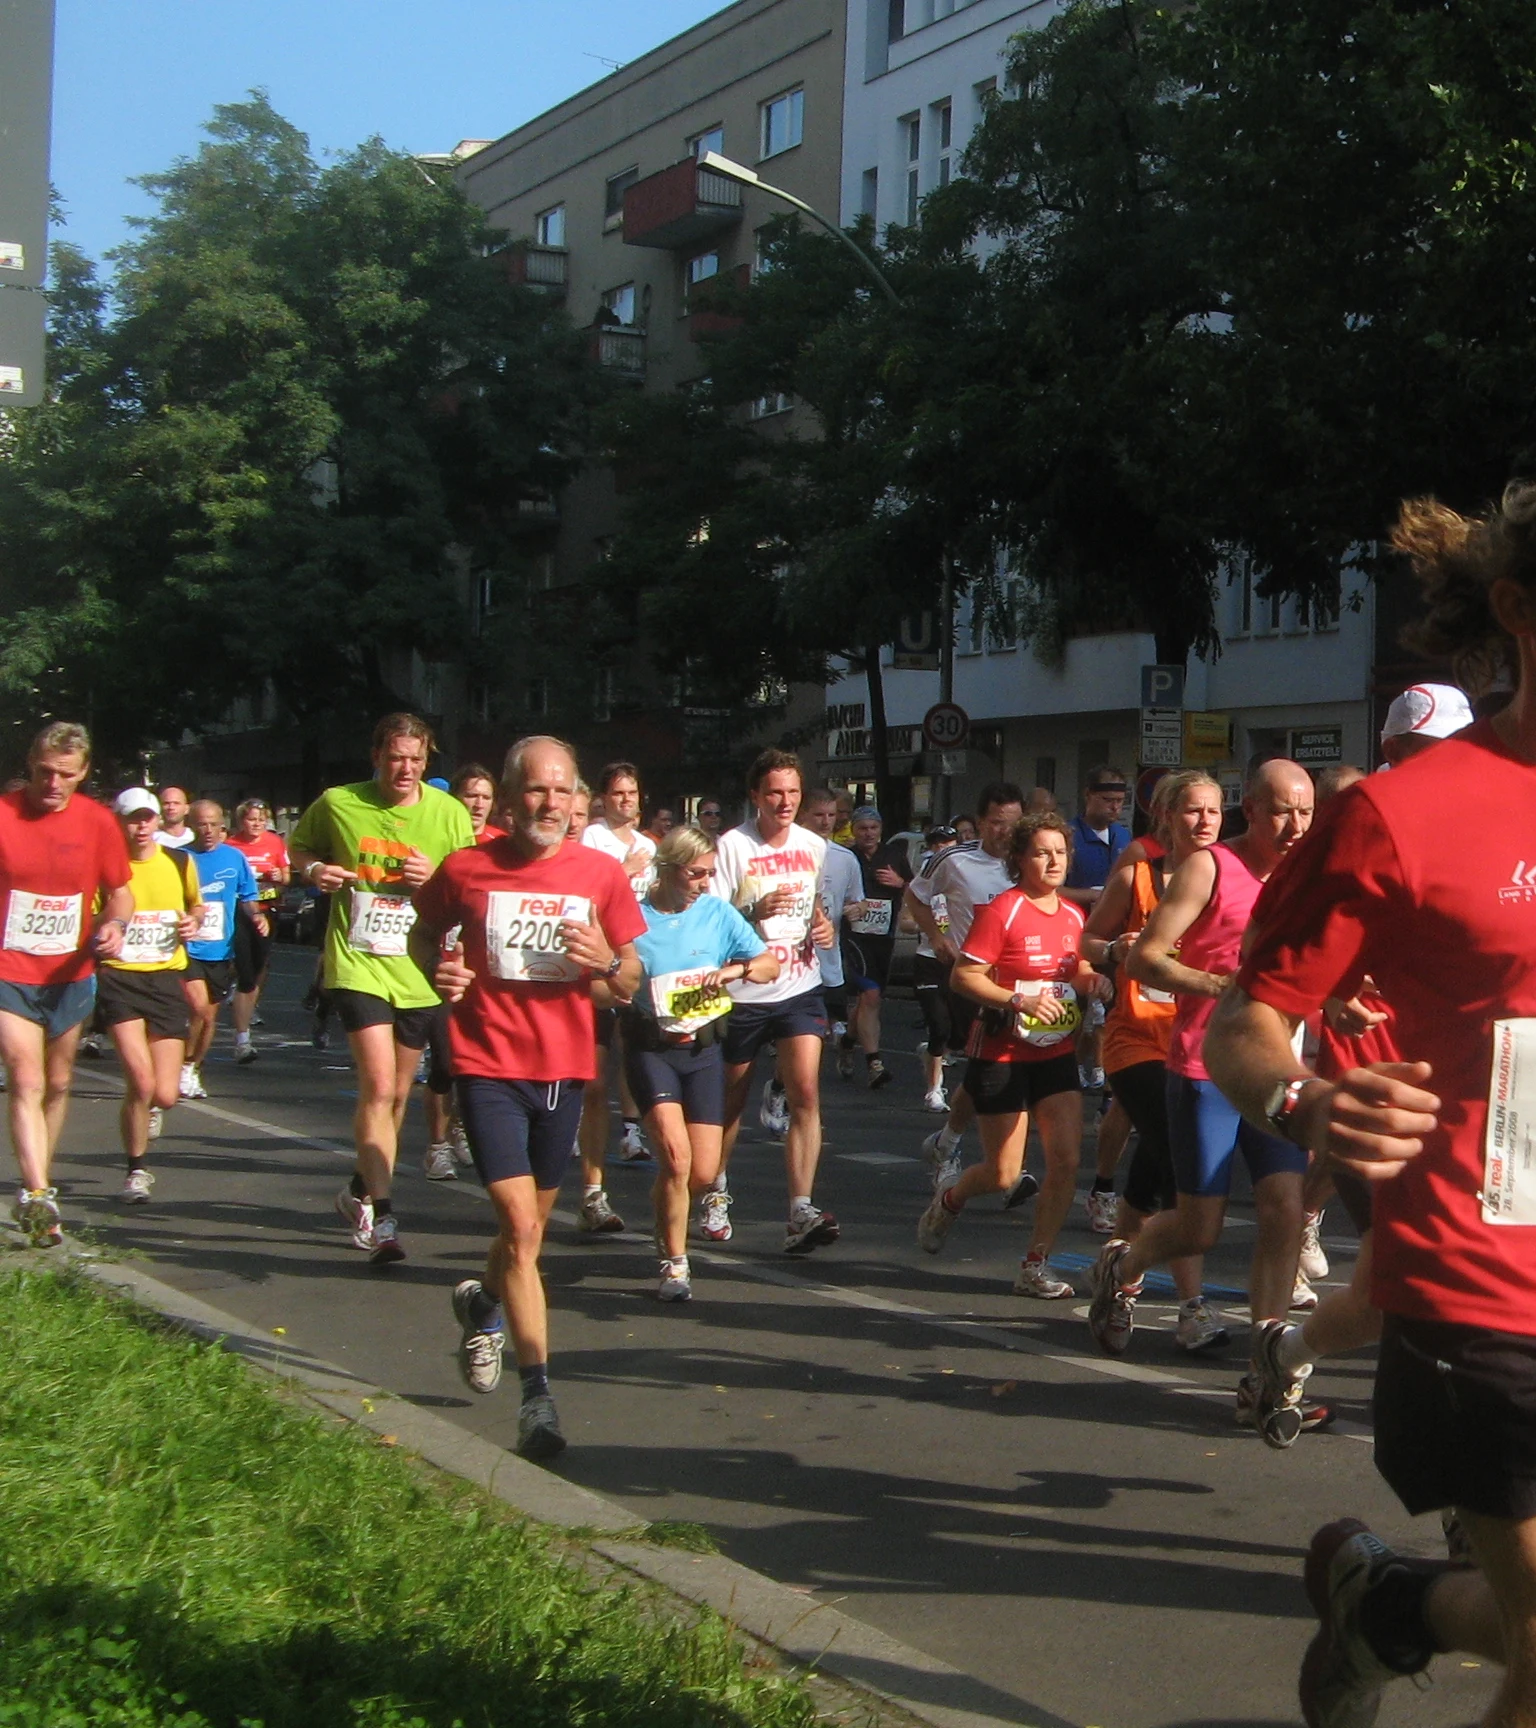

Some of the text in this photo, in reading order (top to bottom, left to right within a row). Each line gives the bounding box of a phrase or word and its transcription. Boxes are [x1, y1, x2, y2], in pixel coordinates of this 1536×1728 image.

[901, 610, 932, 652] U
[1151, 670, 1173, 702] P
[932, 715, 959, 736] 30
[747, 849, 816, 876] STEPHAN
[22, 913, 76, 936] 32300
[364, 912, 414, 935] 15555
